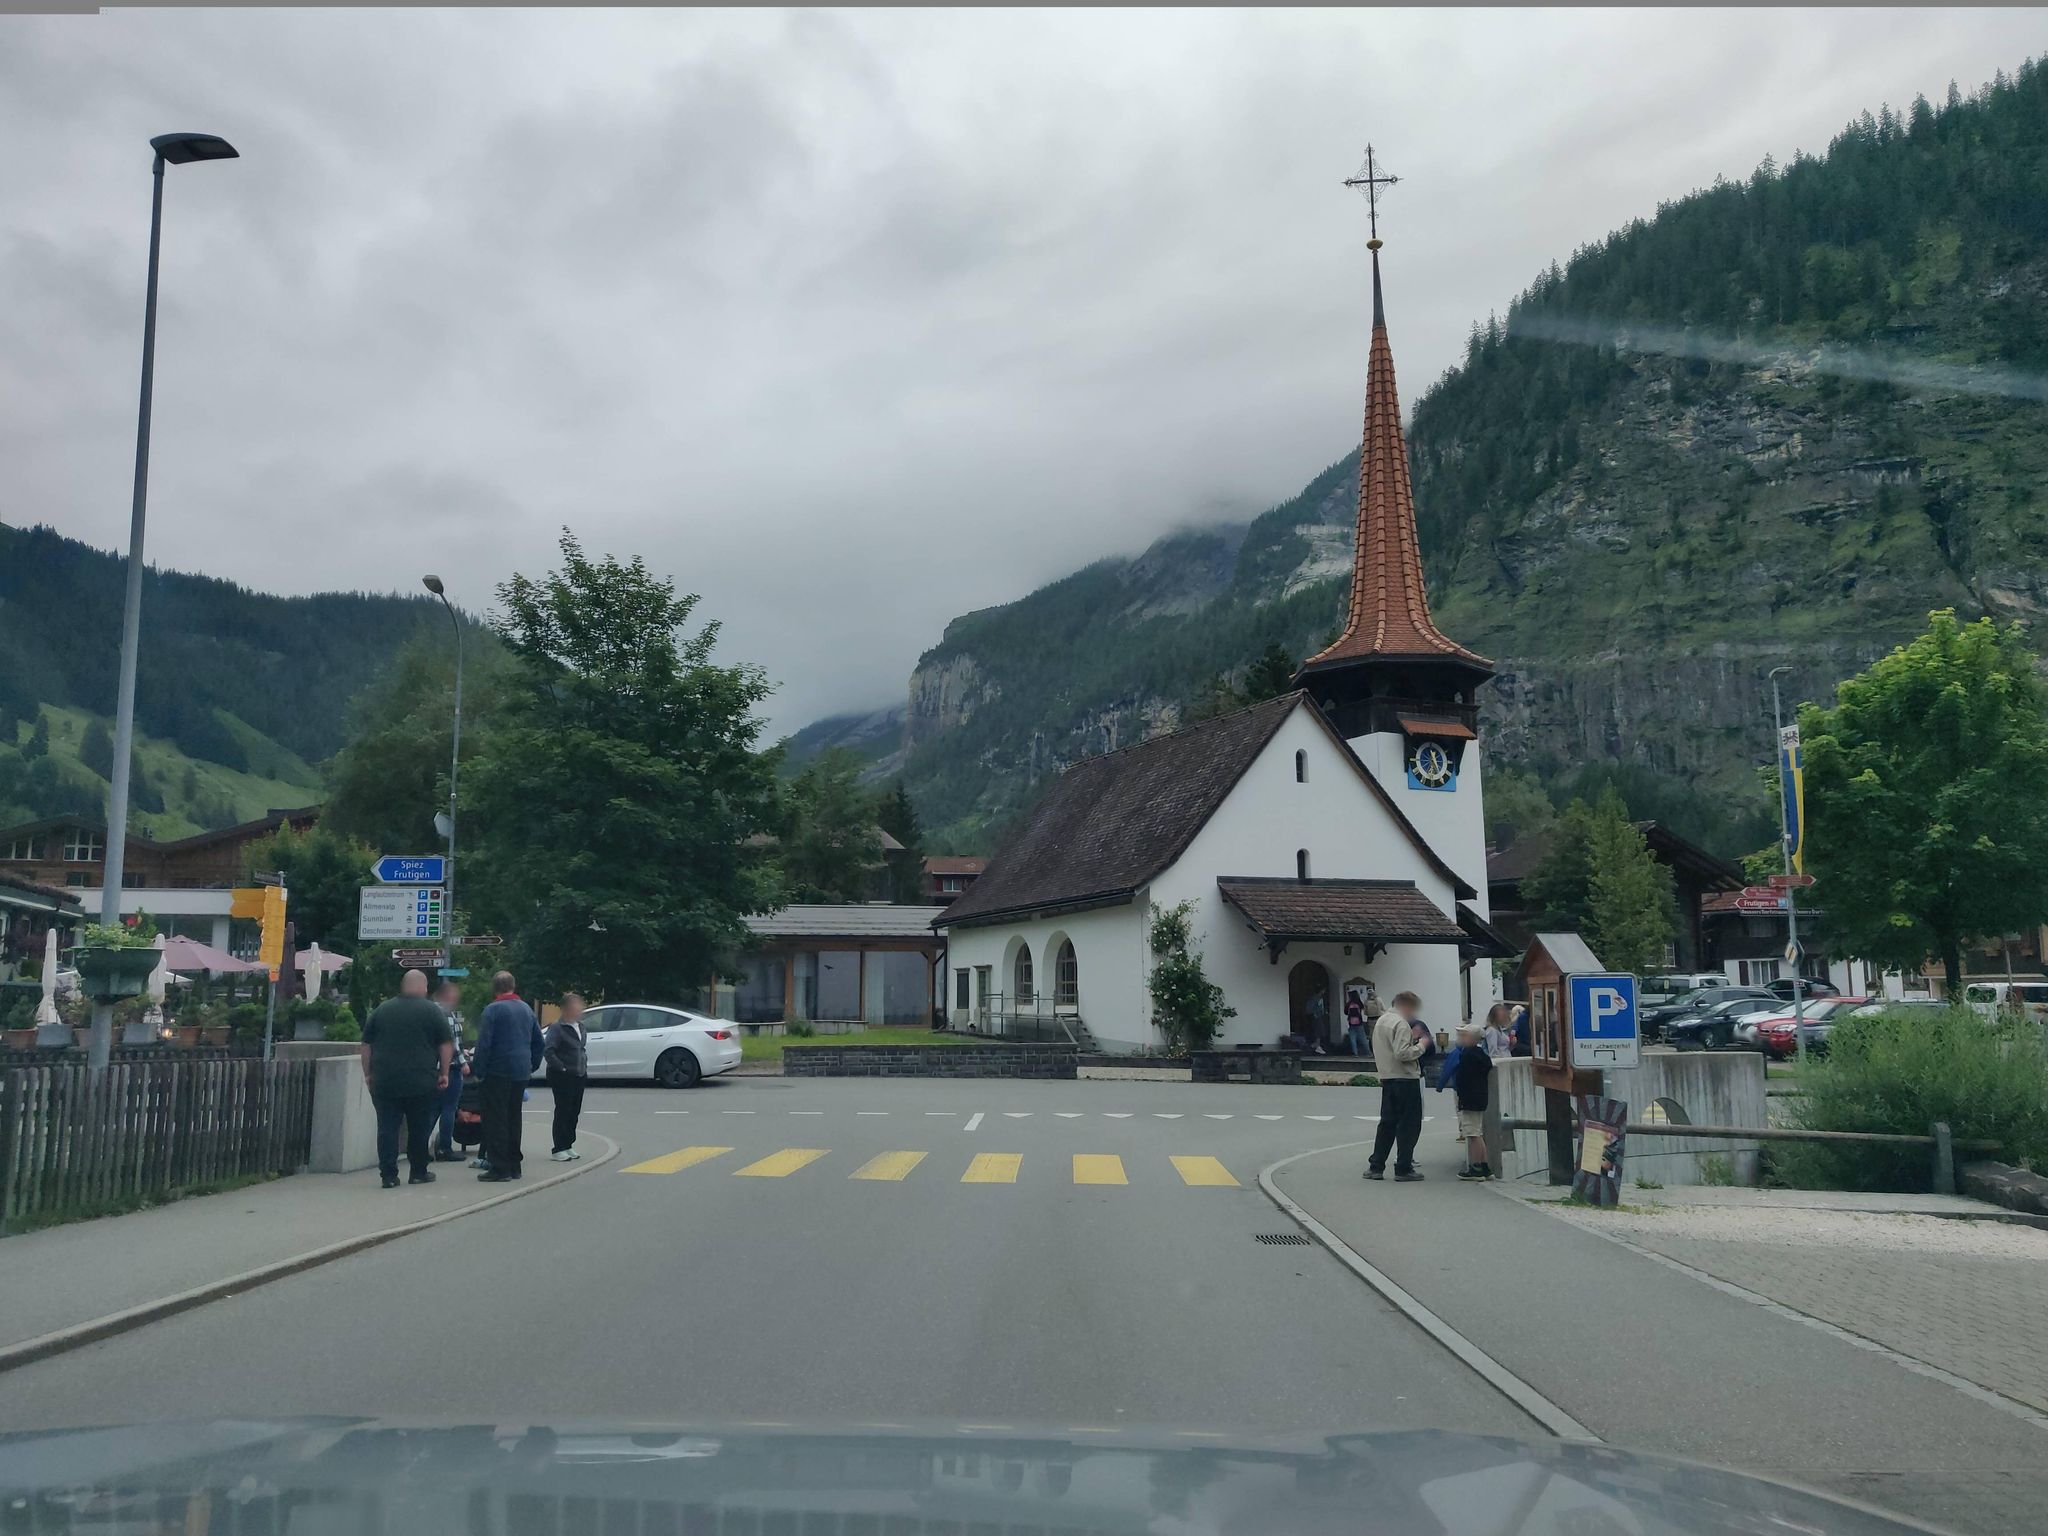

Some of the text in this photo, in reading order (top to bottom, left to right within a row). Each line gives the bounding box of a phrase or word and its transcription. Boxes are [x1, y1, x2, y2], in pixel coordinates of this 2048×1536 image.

[401, 861, 424, 869] Spiez
[394, 871, 430, 880] Frutigen
[1743, 900, 1770, 908] Frutigen
[1589, 987, 1621, 1032] P
